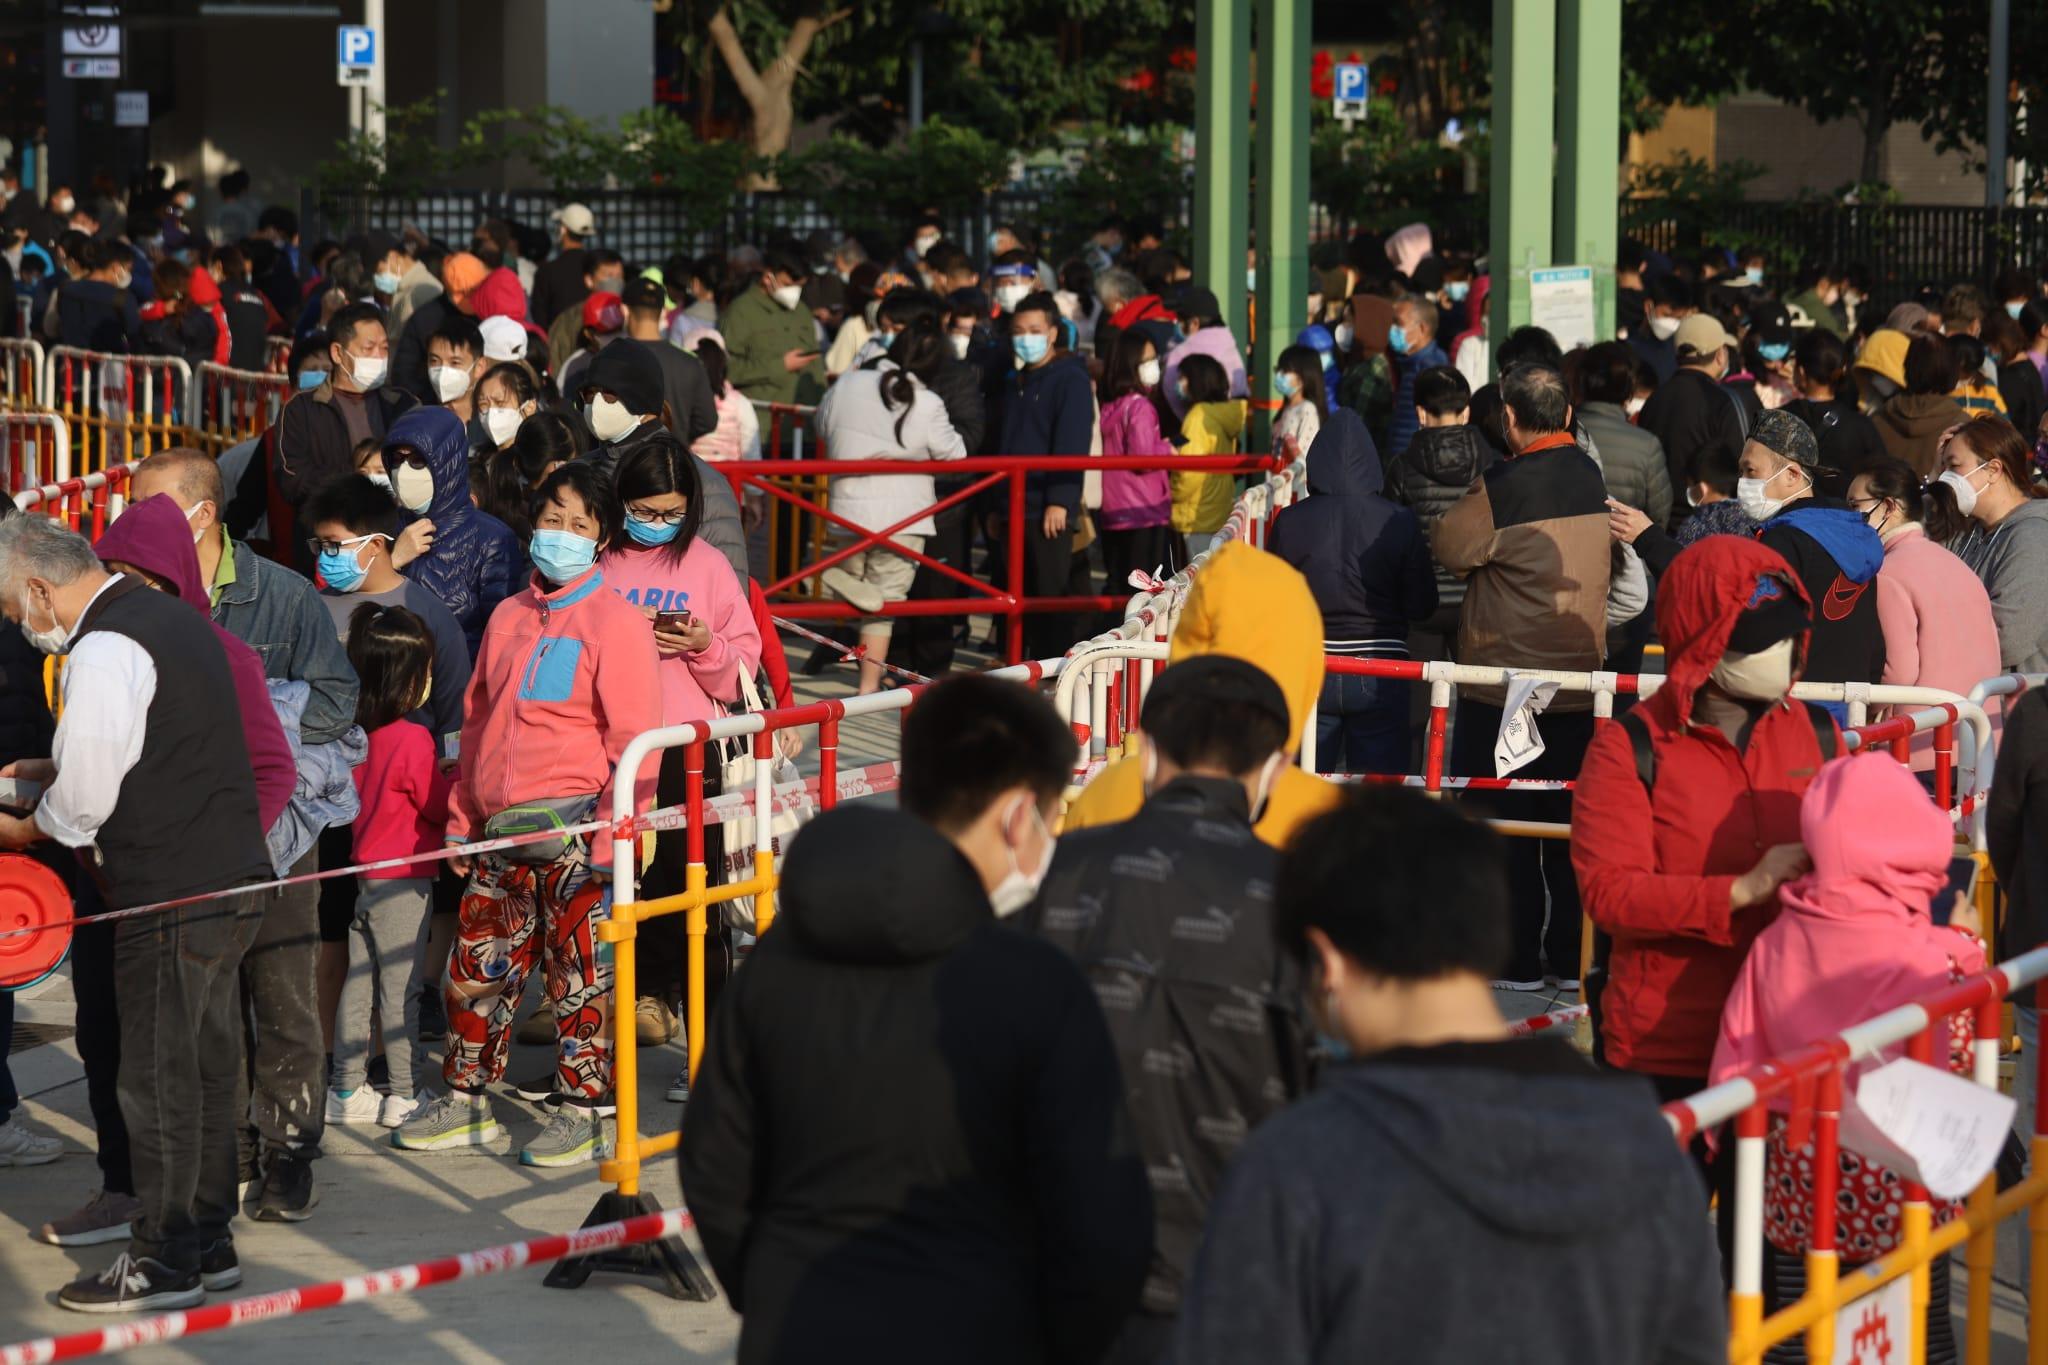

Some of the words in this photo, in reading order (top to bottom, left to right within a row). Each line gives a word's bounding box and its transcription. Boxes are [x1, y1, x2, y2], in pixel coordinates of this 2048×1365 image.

[346, 30, 369, 63] P
[1340, 68, 1361, 98] P
[614, 587, 689, 613] ARIS
